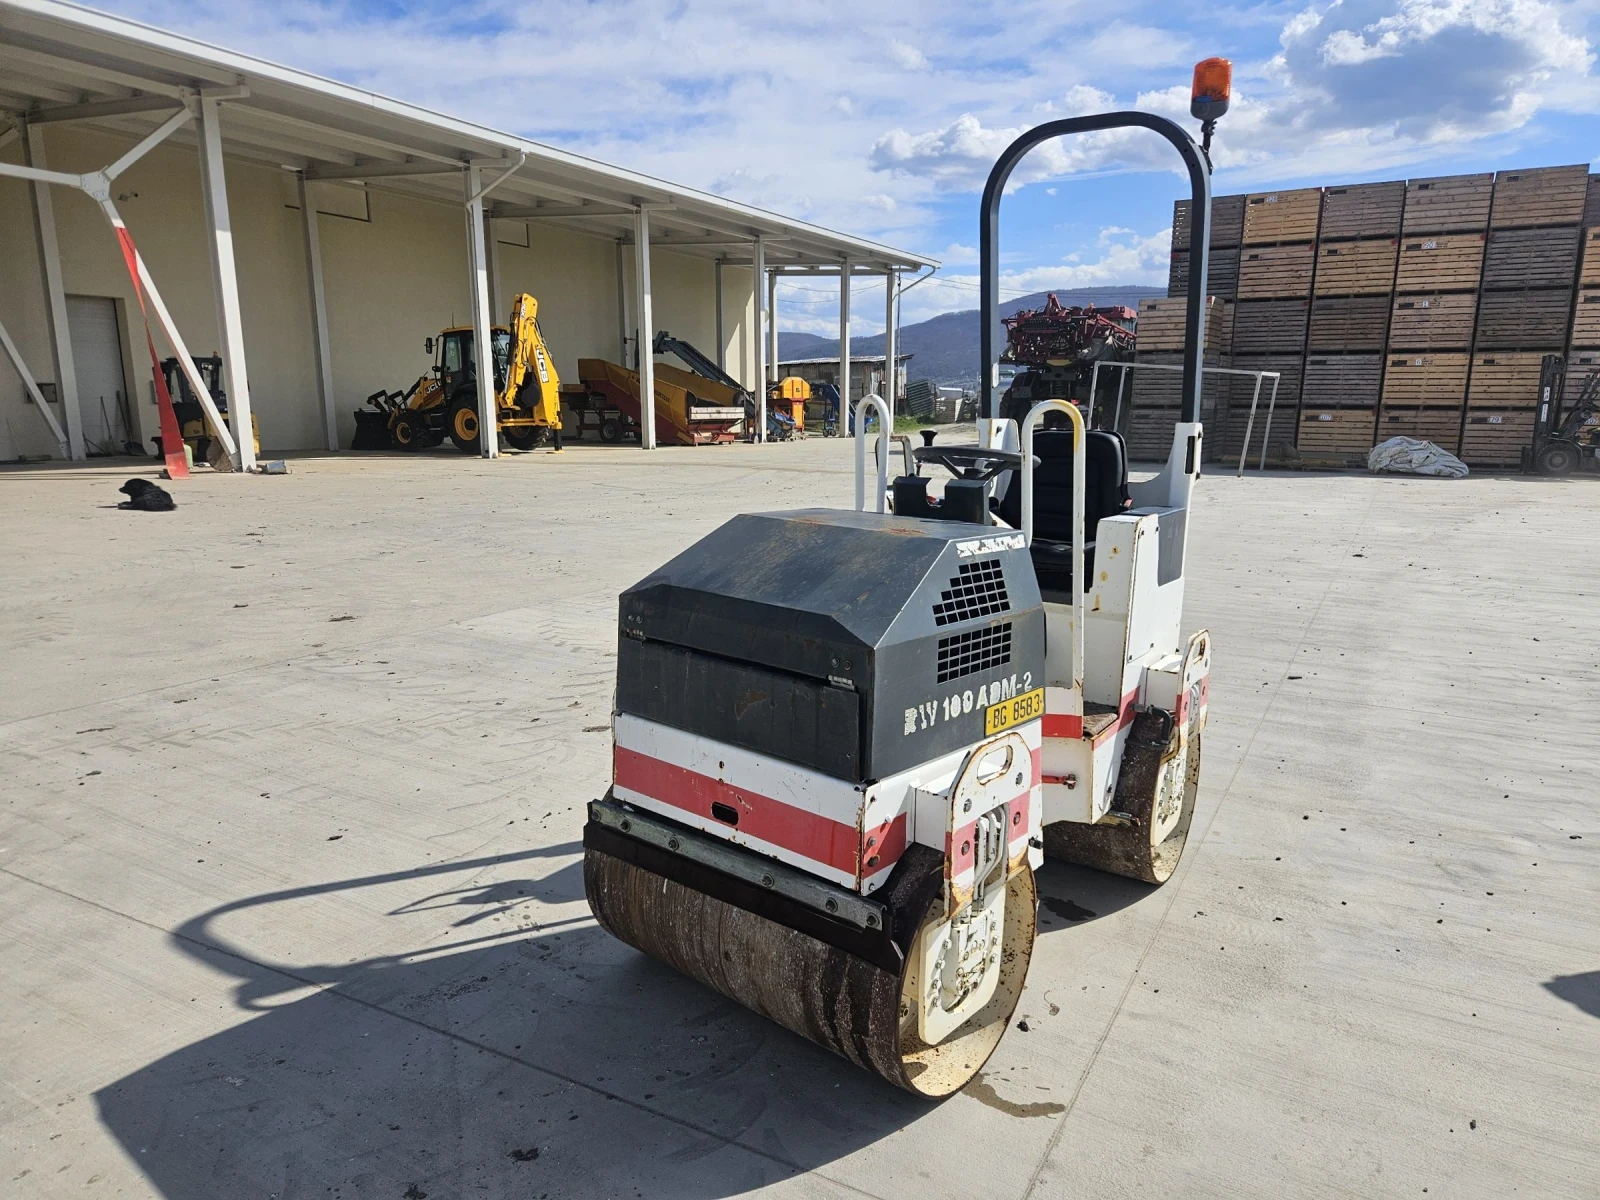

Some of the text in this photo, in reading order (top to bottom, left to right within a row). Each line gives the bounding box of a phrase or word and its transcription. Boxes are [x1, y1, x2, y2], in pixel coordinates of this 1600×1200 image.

[535, 348, 549, 383] JCB
[943, 690, 973, 722] 100
[993, 693, 1040, 729] BG 8583
